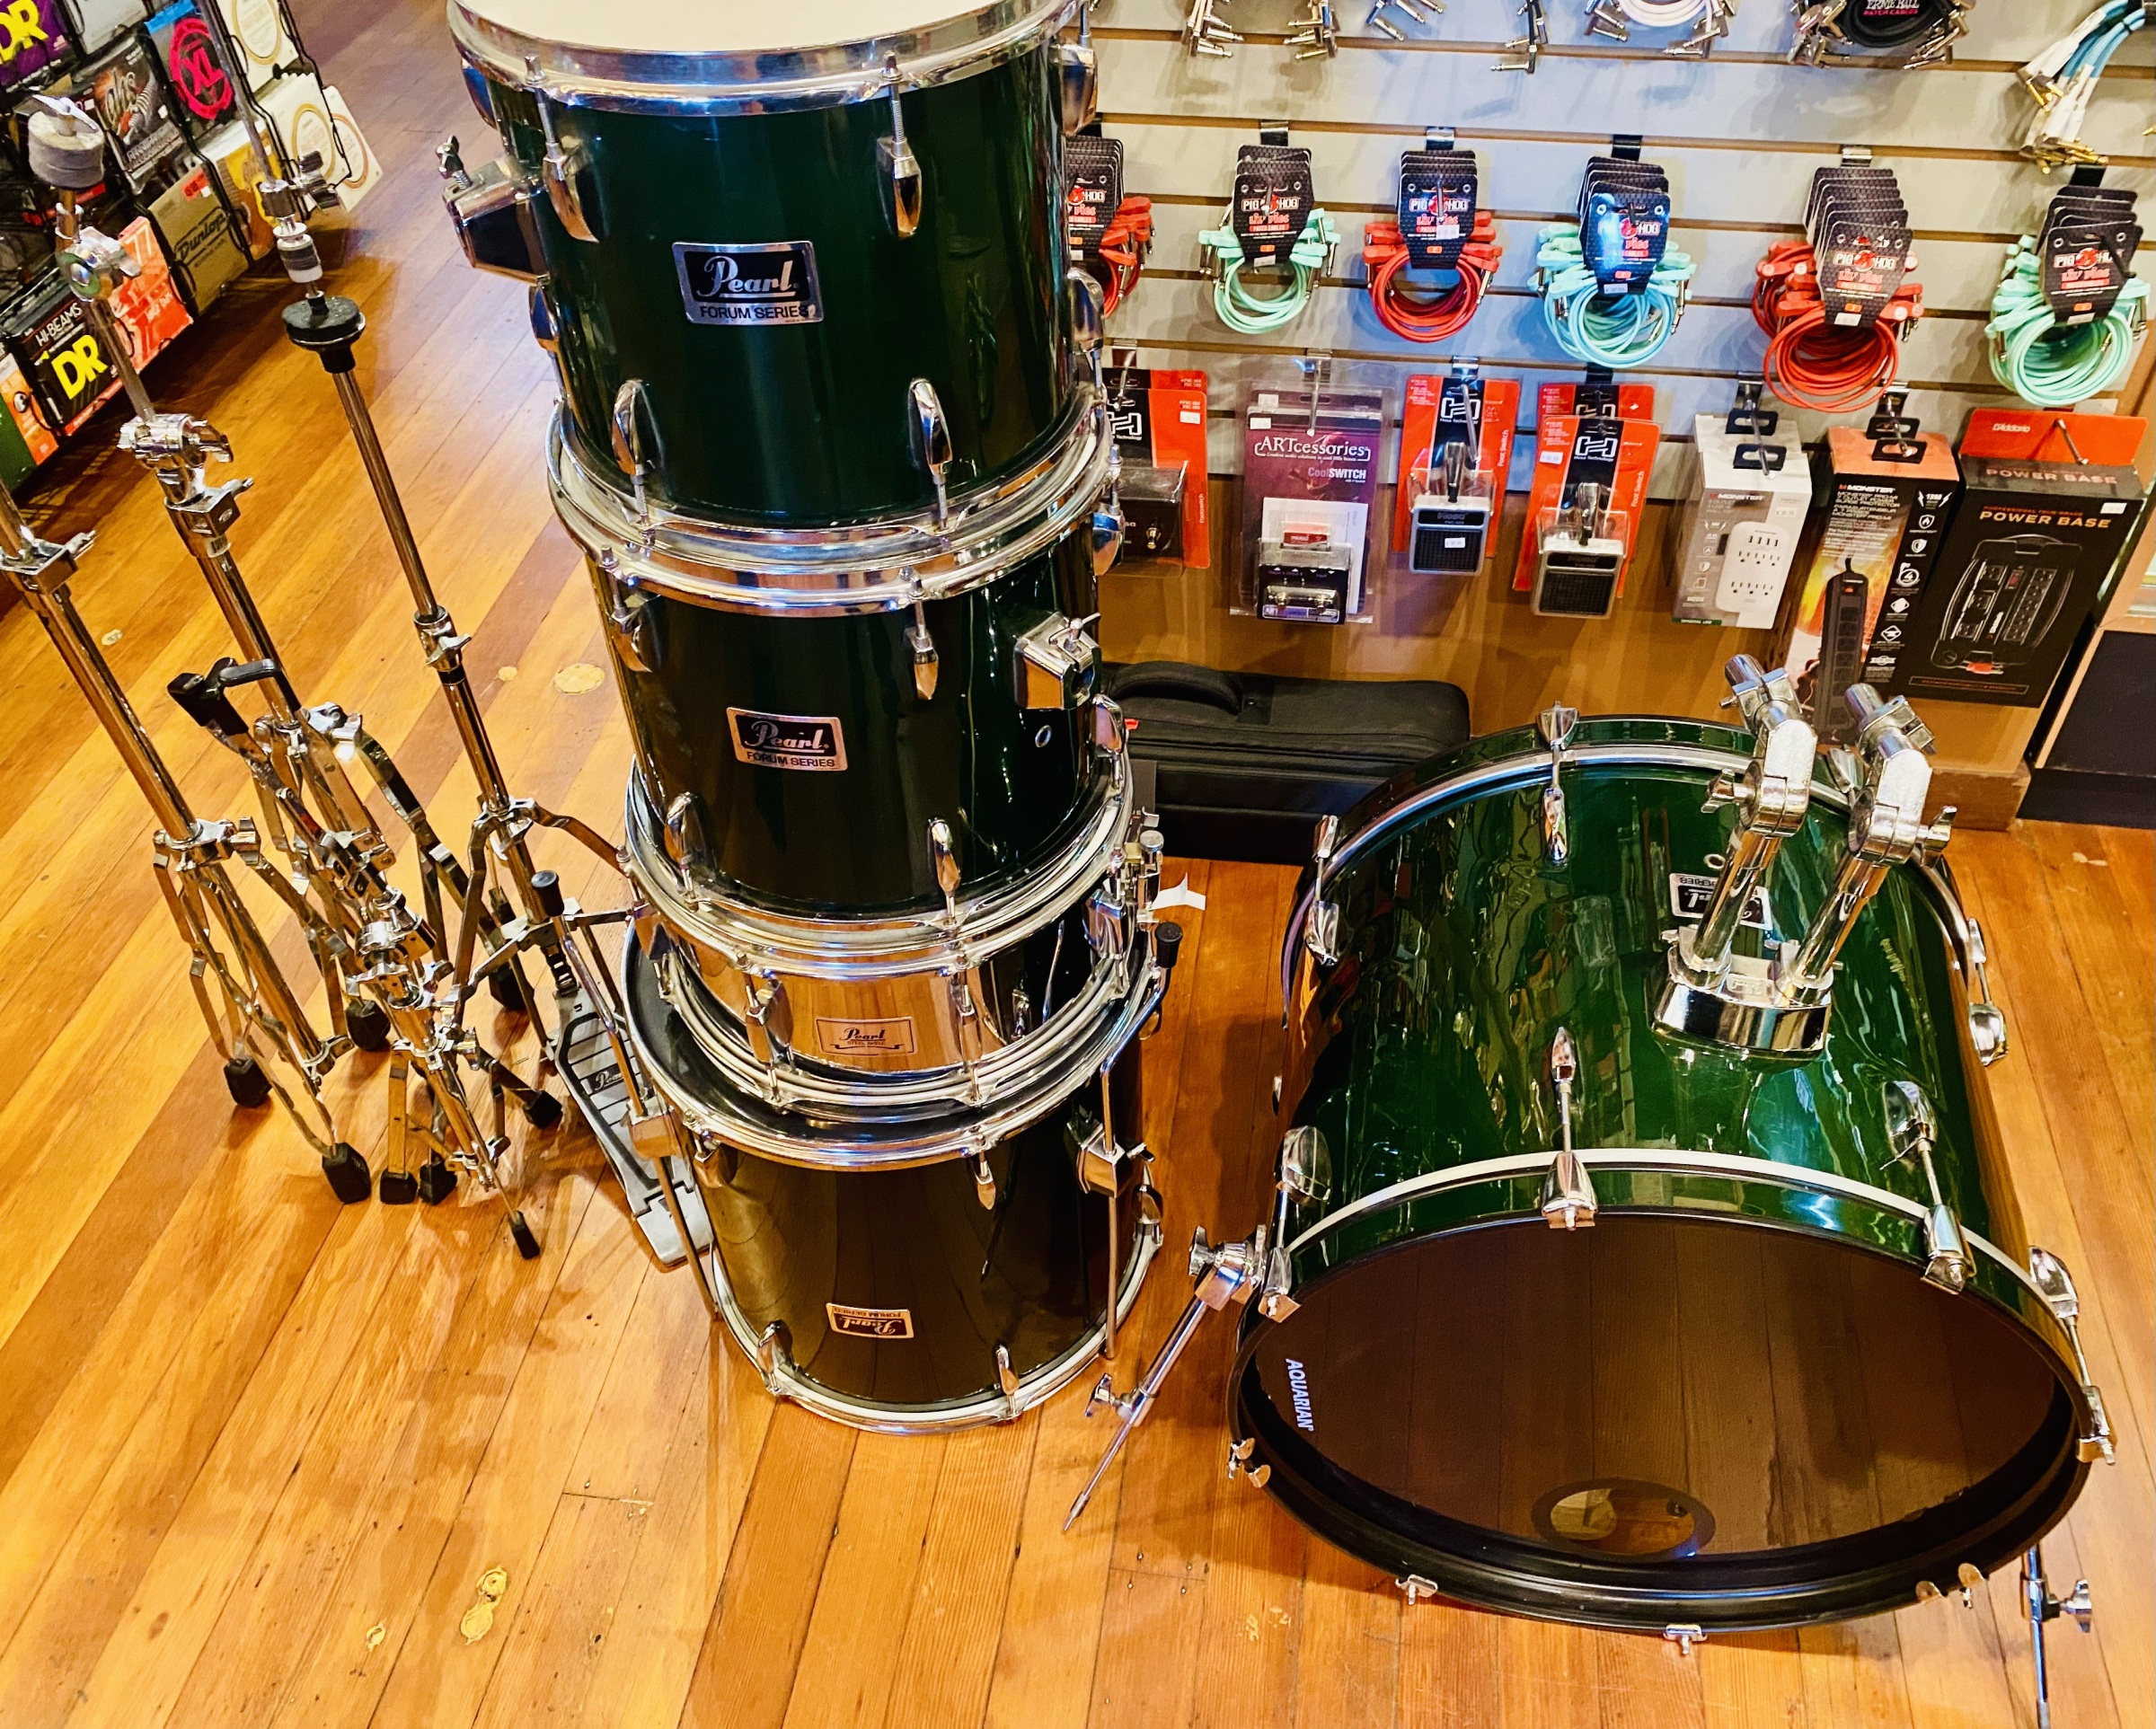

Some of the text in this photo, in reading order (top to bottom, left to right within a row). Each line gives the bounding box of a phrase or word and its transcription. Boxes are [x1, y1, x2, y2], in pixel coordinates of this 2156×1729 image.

[181, 47, 225, 95] XL
[1085, 190, 1105, 203] HOG
[1243, 198, 1298, 211] PIG HOG
[1410, 199, 1468, 211] PIG HOG
[176, 211, 227, 261] Dunlop
[1638, 222, 1659, 234] HOG
[1834, 252, 1895, 269] PIG HOG
[2054, 254, 2075, 267] PIG
[696, 255, 794, 298] Pearl
[700, 305, 810, 320] FORUM SERIES
[35, 302, 83, 347] HI-BEAMS
[51, 334, 108, 400] DR
[1259, 436, 1365, 456] ARTcessories
[1985, 468, 2057, 481] POWER
[2063, 473, 2117, 484] BASE
[1718, 493, 1765, 501] MONSTER
[1847, 484, 1895, 493] MONSTER
[1979, 511, 2111, 528] POWER BASE
[744, 720, 824, 750] Pearl
[747, 751, 835, 768] FORUM SERIES
[839, 1027, 886, 1041] Pearl
[842, 1318, 903, 1336] Pearl
[1285, 1357, 1313, 1432] AQUARIAN
